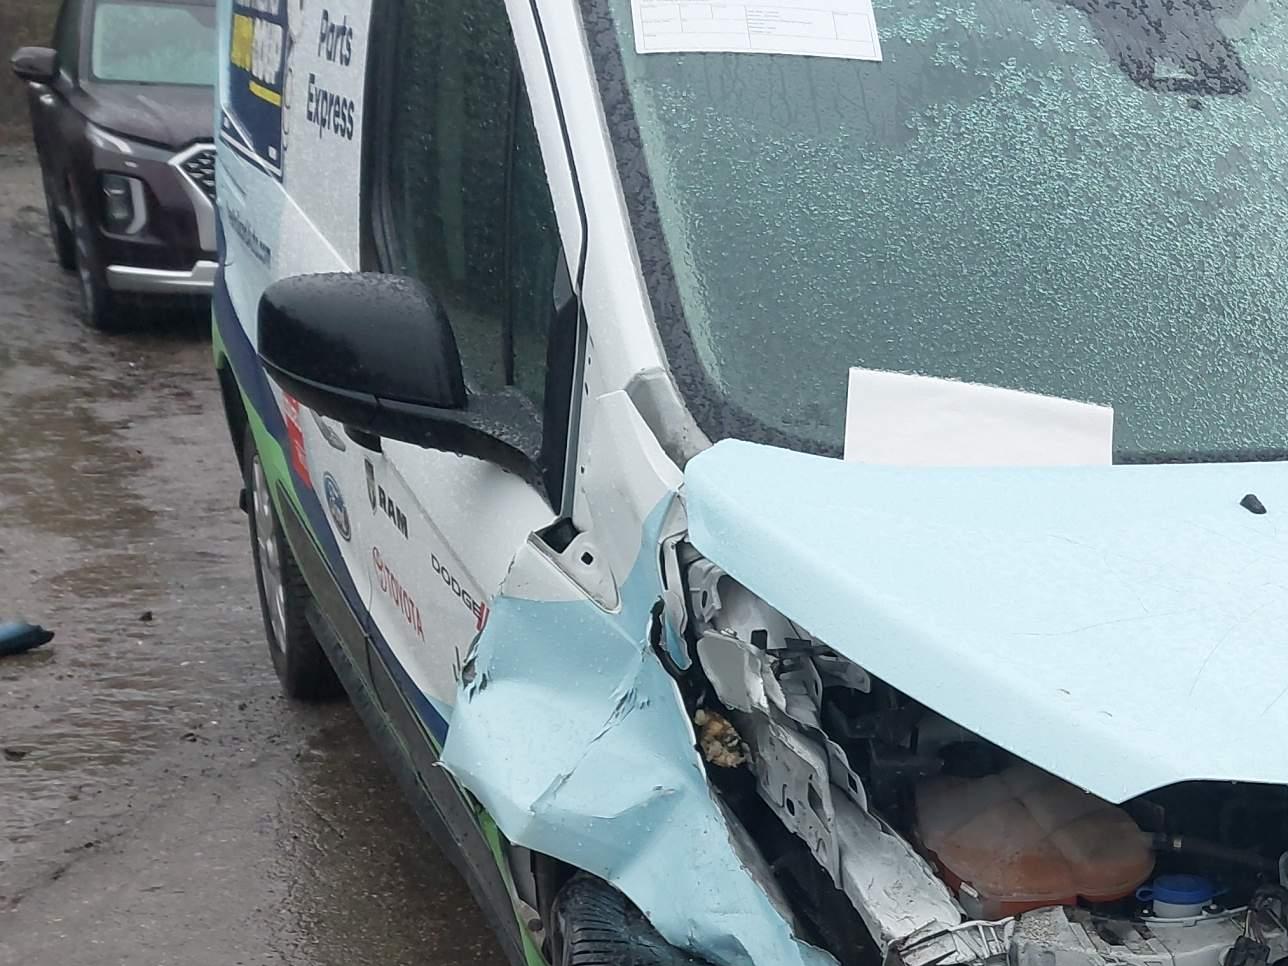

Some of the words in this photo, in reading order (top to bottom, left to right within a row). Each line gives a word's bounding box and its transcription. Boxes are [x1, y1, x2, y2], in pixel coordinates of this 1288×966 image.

[318, 9, 353, 67] Parts
[306, 72, 355, 141] Express
[378, 485, 410, 541] RAM
[381, 566, 425, 641] TOYOTA
[430, 553, 483, 620] DODGE
